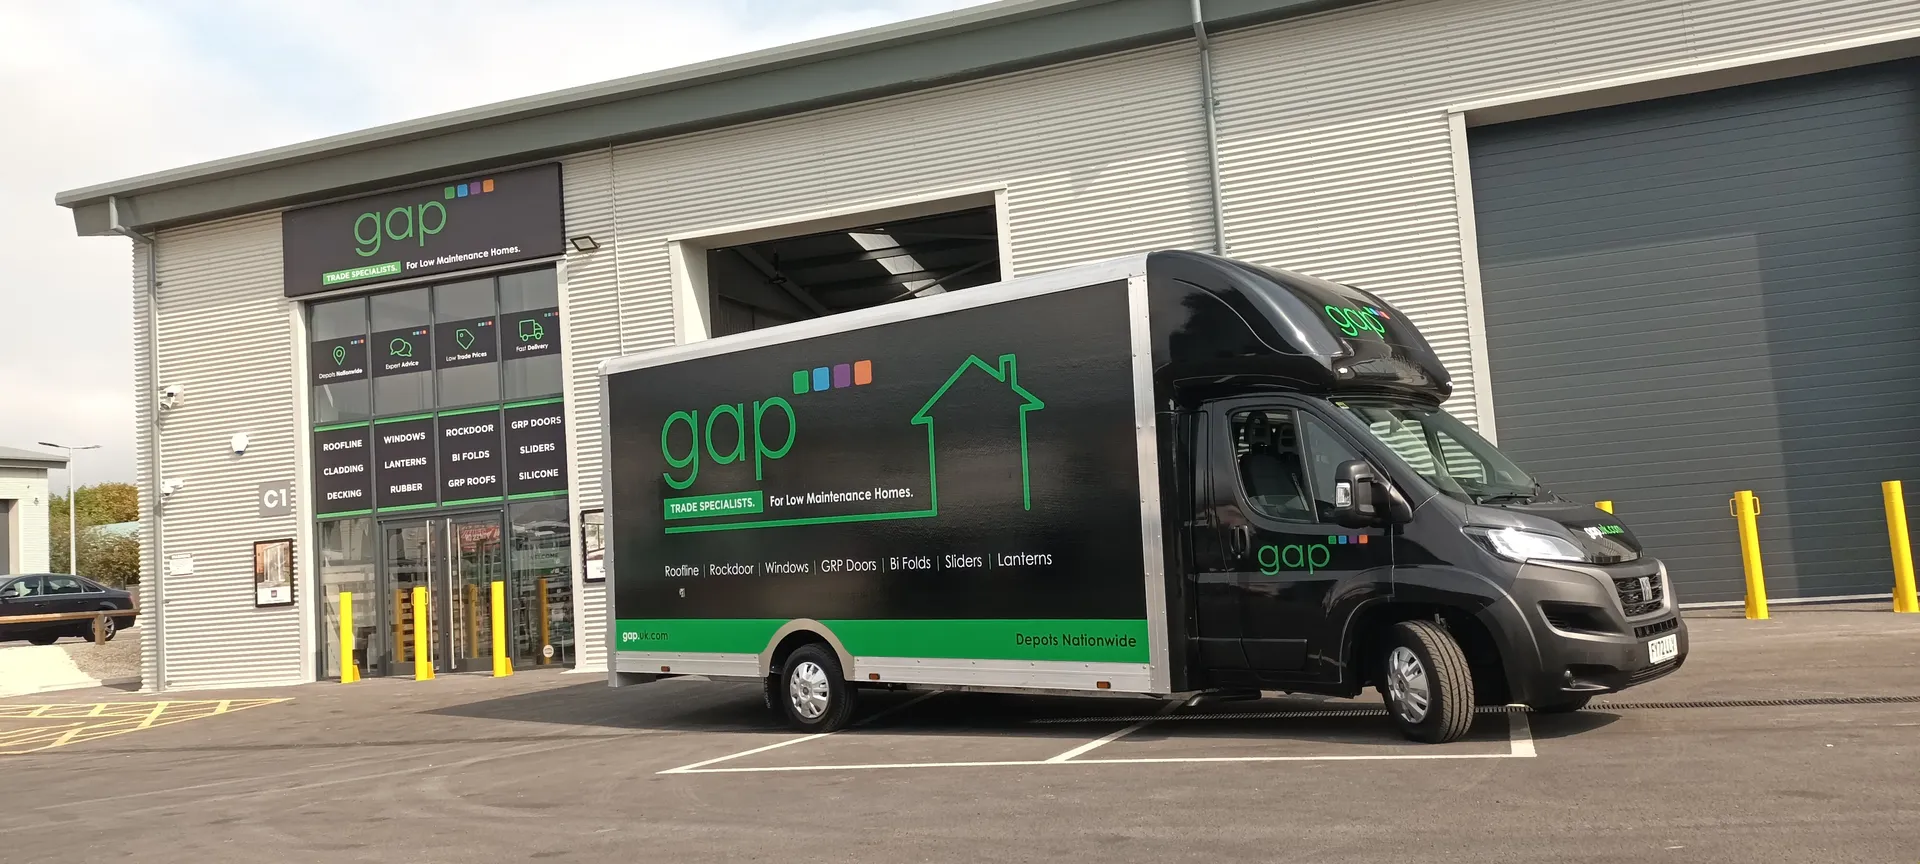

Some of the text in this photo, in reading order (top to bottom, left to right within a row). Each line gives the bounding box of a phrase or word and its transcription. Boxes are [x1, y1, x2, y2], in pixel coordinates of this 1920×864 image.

[354, 201, 447, 256] gap
[326, 245, 521, 282] TRADE SPECIALISTS. For Low Maintenance Homes.
[1324, 305, 1386, 339] gap
[527, 343, 549, 351] Delivery
[385, 360, 419, 371] Expert Advice
[318, 367, 363, 380] Depots Nationwide
[511, 416, 562, 430] GRP DOORS
[445, 424, 494, 437] ROCKDOOR
[383, 432, 426, 444] WINDOWS
[661, 396, 796, 489] gap
[323, 440, 363, 452] ROOFLINE
[519, 443, 556, 455] SLIDERS
[451, 450, 490, 462] BI FOLDS
[384, 457, 427, 469] LANTERNS
[323, 464, 364, 476] CLADDING
[518, 469, 559, 480] SILICONE
[447, 475, 496, 488] GRP ROOFS
[326, 489, 362, 501] DECKING
[390, 483, 423, 494] RUBBER
[263, 488, 288, 509] C1
[670, 487, 914, 513] TRADE SPECIALISTS. For Low Maintenance Homes.
[664, 551, 1053, 578] Roofline Rockdoor Windows GRP Doors Bi Folds Sliders Lanterns
[1257, 543, 1330, 576] gap
[1016, 633, 1137, 648] Depots Nationwide
